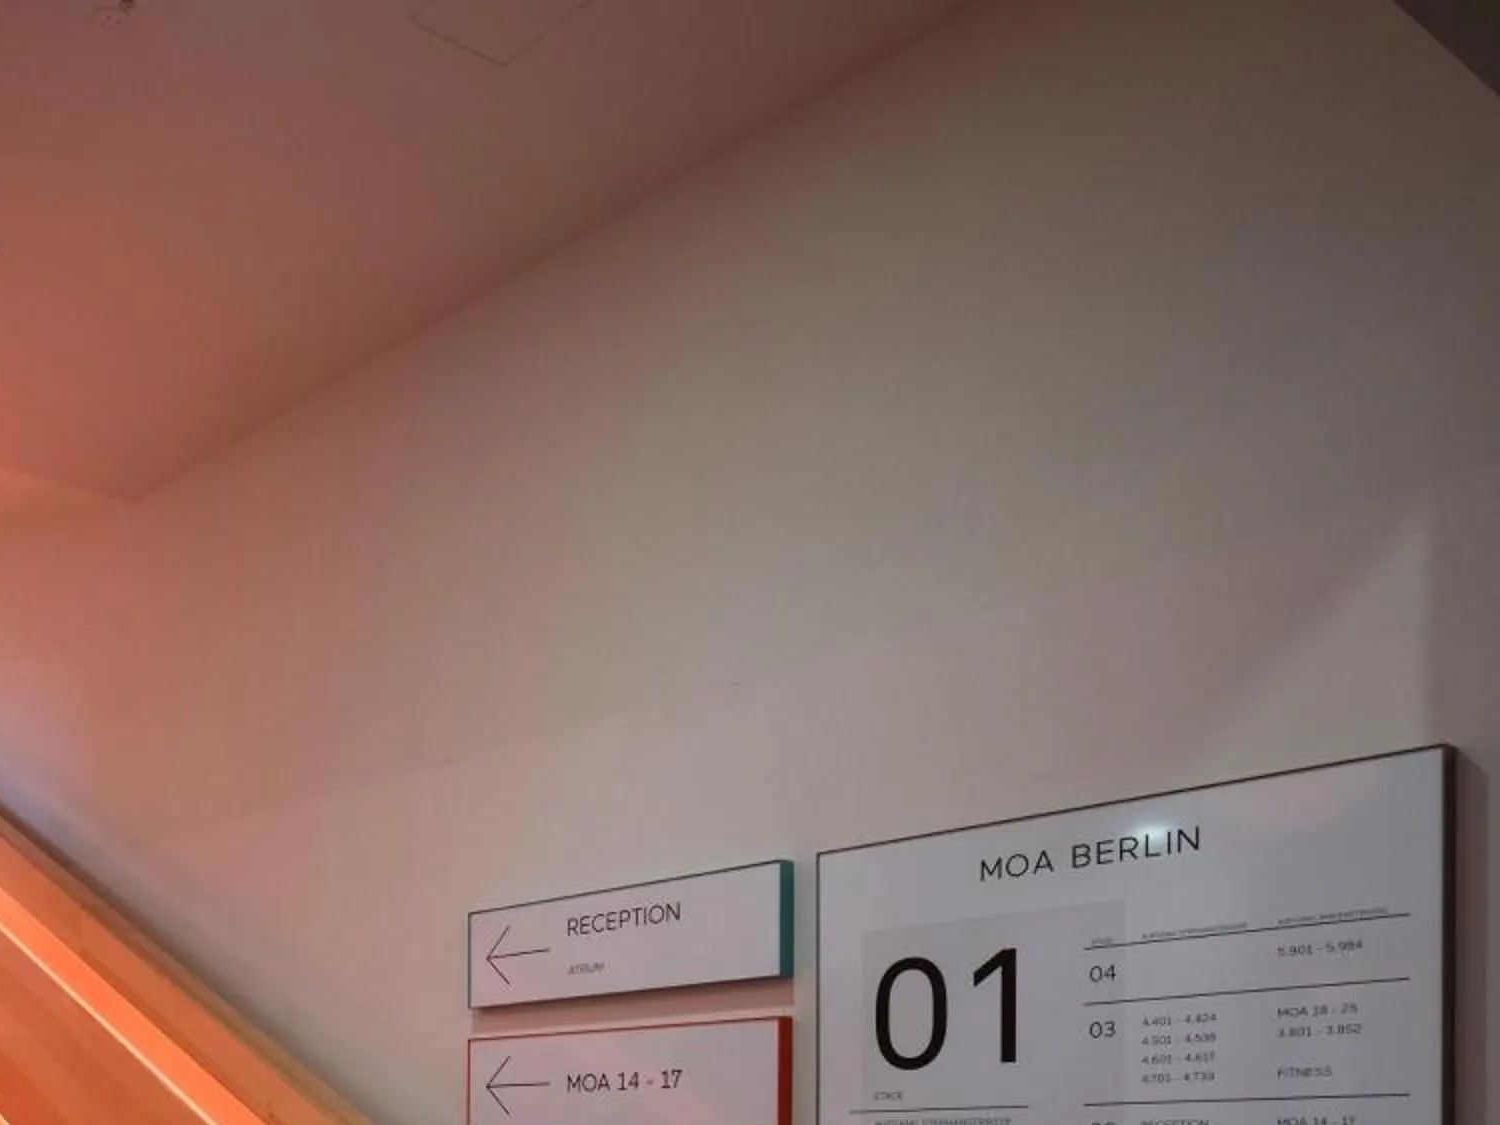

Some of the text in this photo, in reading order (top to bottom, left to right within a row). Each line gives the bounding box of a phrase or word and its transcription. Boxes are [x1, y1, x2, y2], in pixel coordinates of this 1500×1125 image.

[980, 826, 1200, 882] MOA BERLIN
[567, 902, 681, 936] RECEPTION
[1277, 944, 1313, 957] 5.901
[567, 962, 605, 976] ATRIUM
[1089, 964, 1117, 983] 04
[874, 948, 1018, 1071] 01
[1277, 1007, 1308, 1018] MOA
[1089, 1021, 1117, 1039] 03
[567, 1072, 611, 1093] MOA
[618, 1070, 640, 1092] 14
[660, 1069, 682, 1090] 17
[1277, 1065, 1333, 1079] FITNESS
